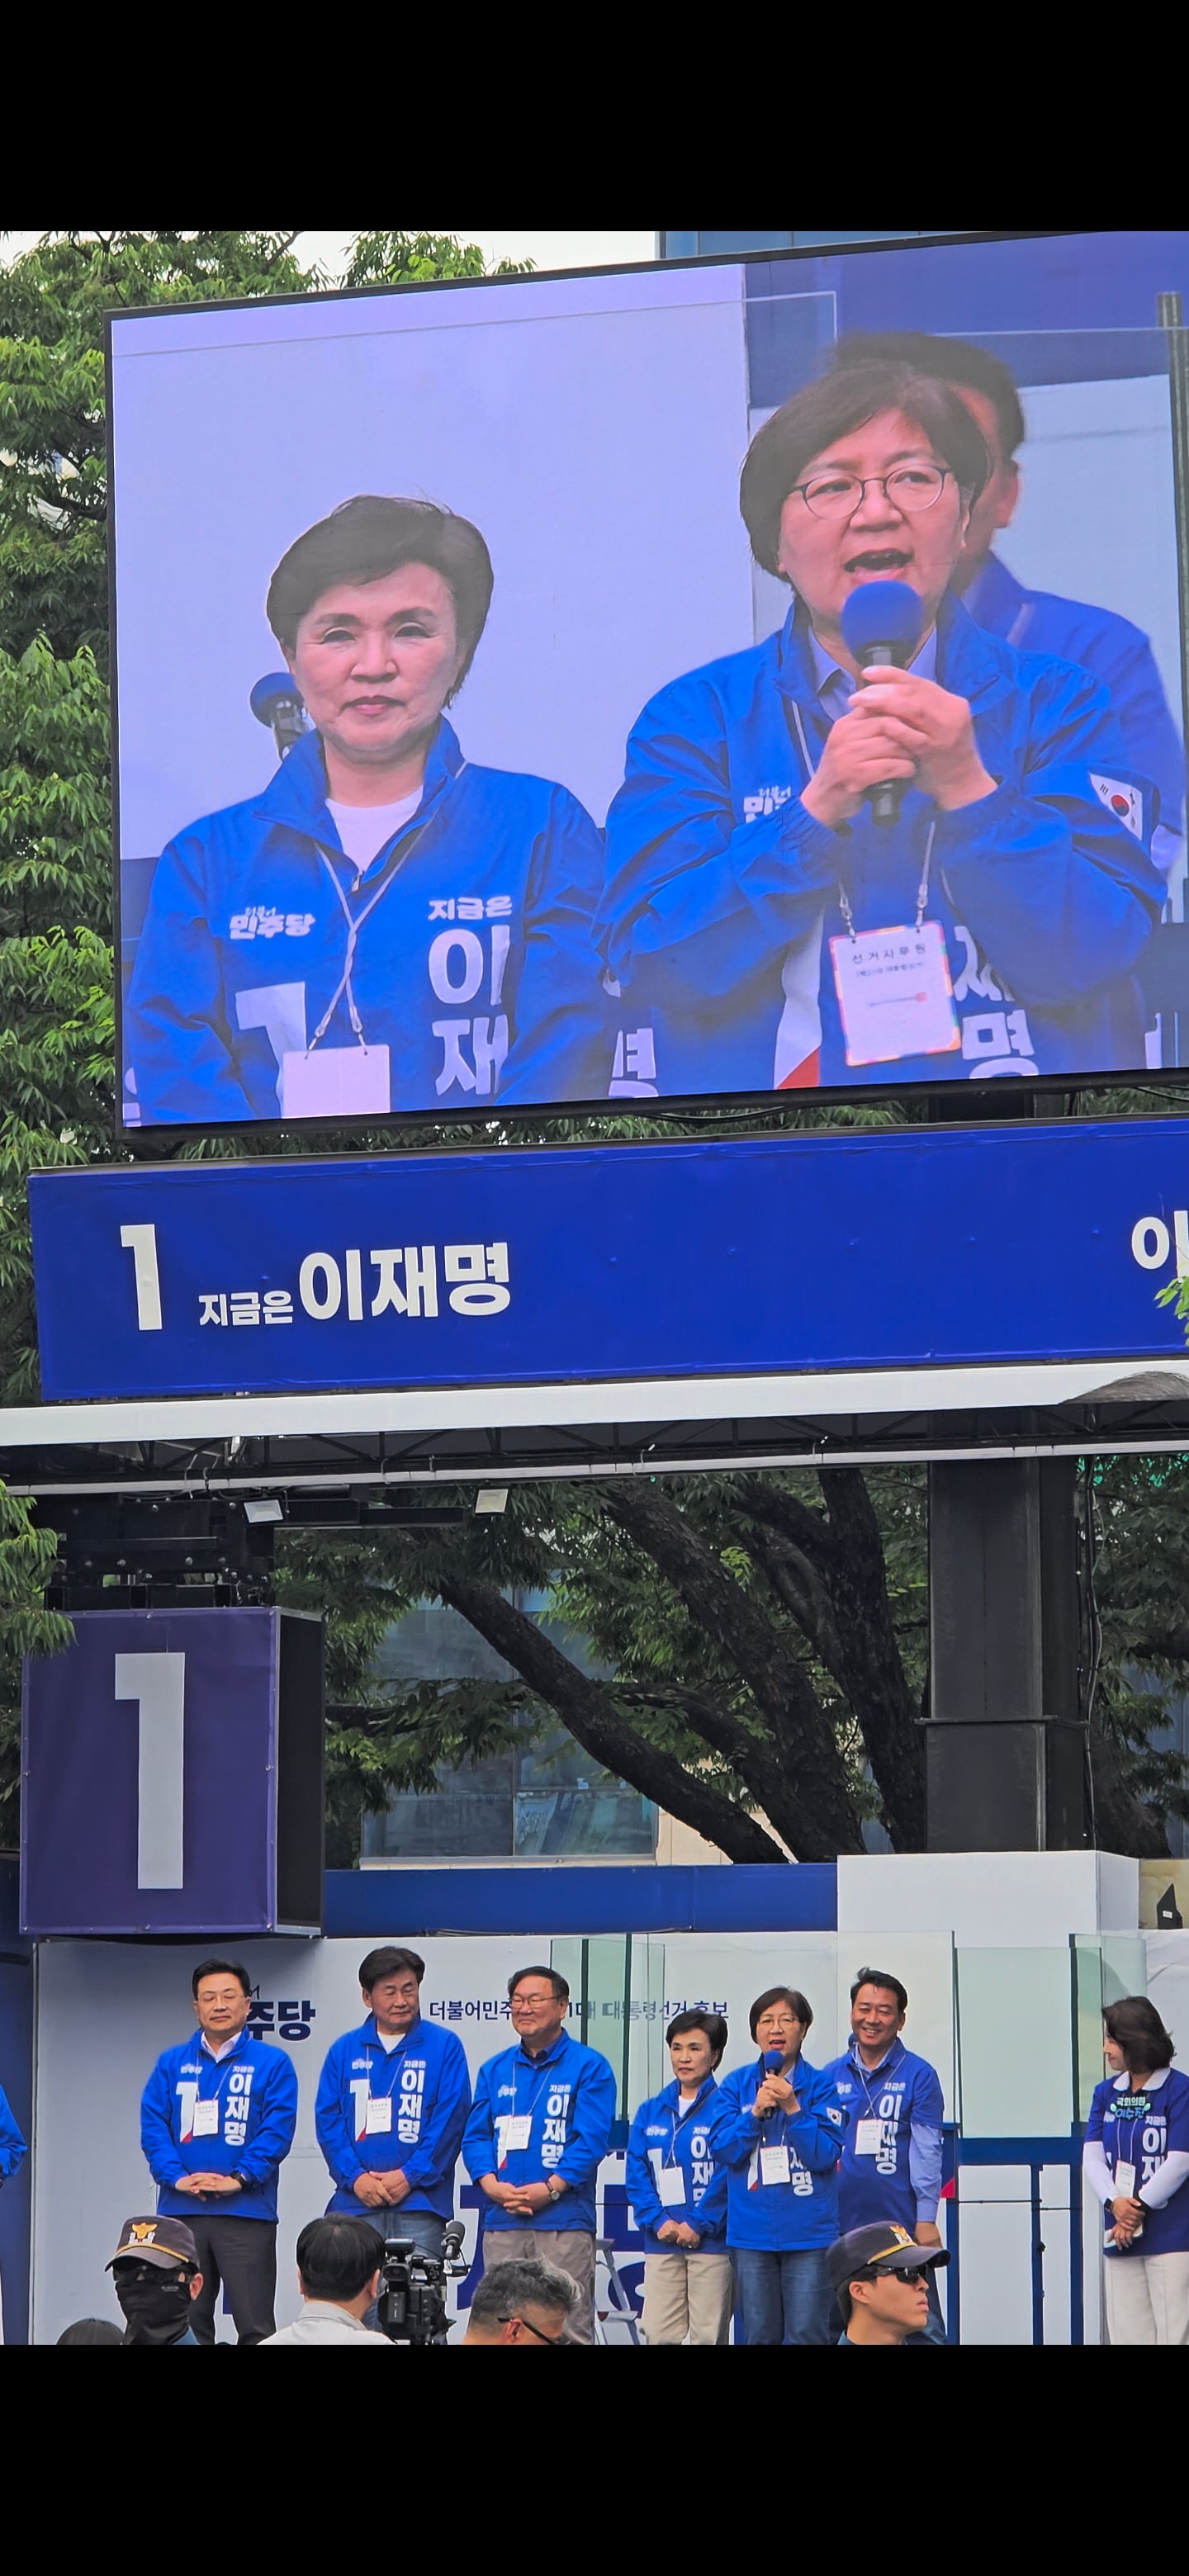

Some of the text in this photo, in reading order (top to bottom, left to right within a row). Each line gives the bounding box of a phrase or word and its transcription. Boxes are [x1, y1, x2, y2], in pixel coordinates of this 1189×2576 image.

[230, 913, 315, 940] 민주당
[428, 895, 513, 921] 지금은
[120, 1224, 511, 1331] 1 지금은 이재명
[115, 1652, 186, 1890] 1
[225, 2073, 253, 2146] 이재명
[398, 2069, 425, 2144] 이재명
[542, 2094, 570, 2169] 이재명
